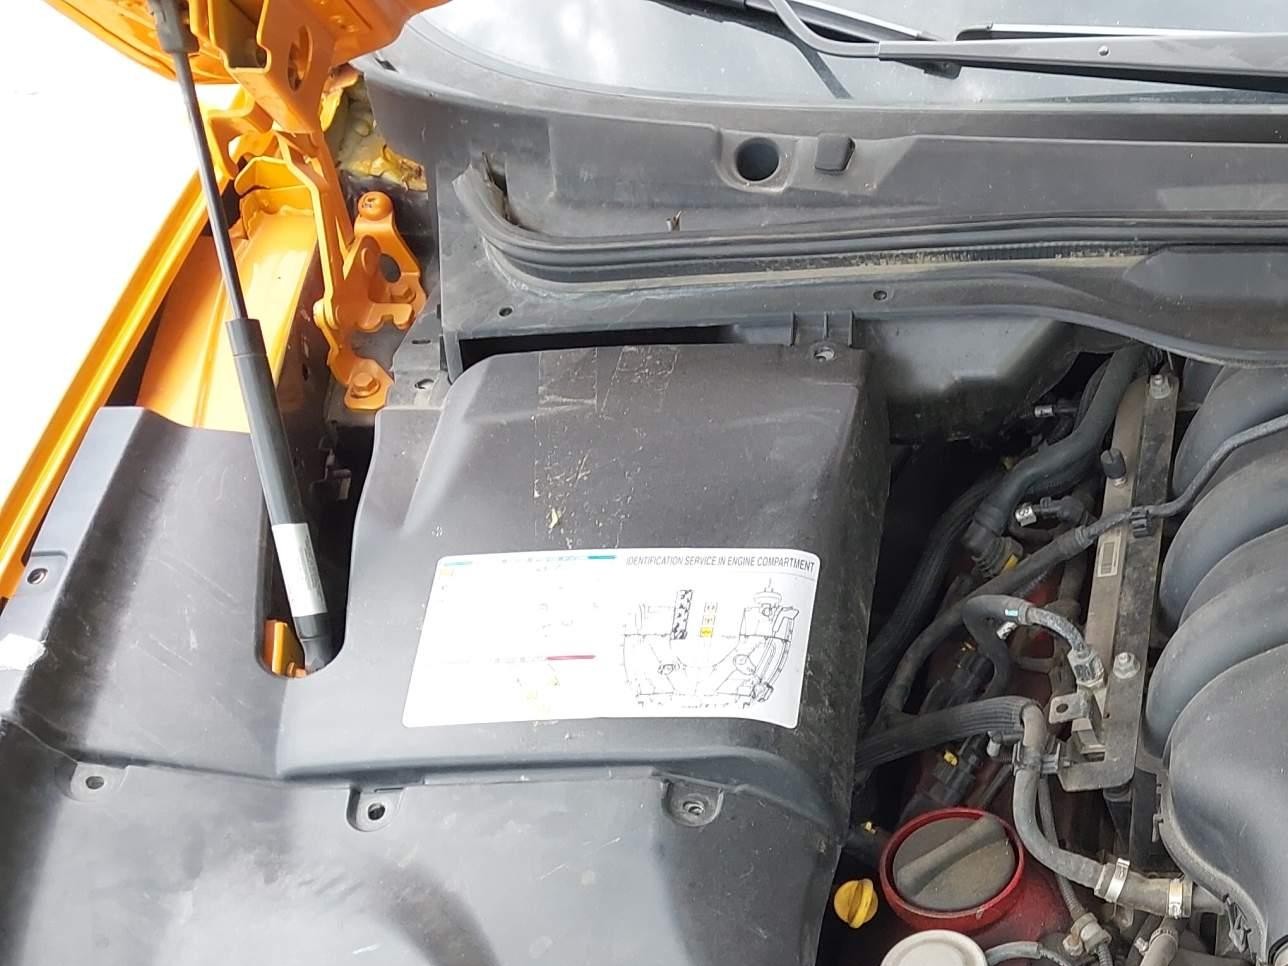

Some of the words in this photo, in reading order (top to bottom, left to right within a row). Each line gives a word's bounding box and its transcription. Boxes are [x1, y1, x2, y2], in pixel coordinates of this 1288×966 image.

[626, 555, 684, 567] IDENTIFICATION
[685, 555, 716, 567] SERVICE
[718, 556, 726, 567] IN
[727, 556, 756, 567] ENGINE
[757, 556, 815, 573] COMPARTMENT
